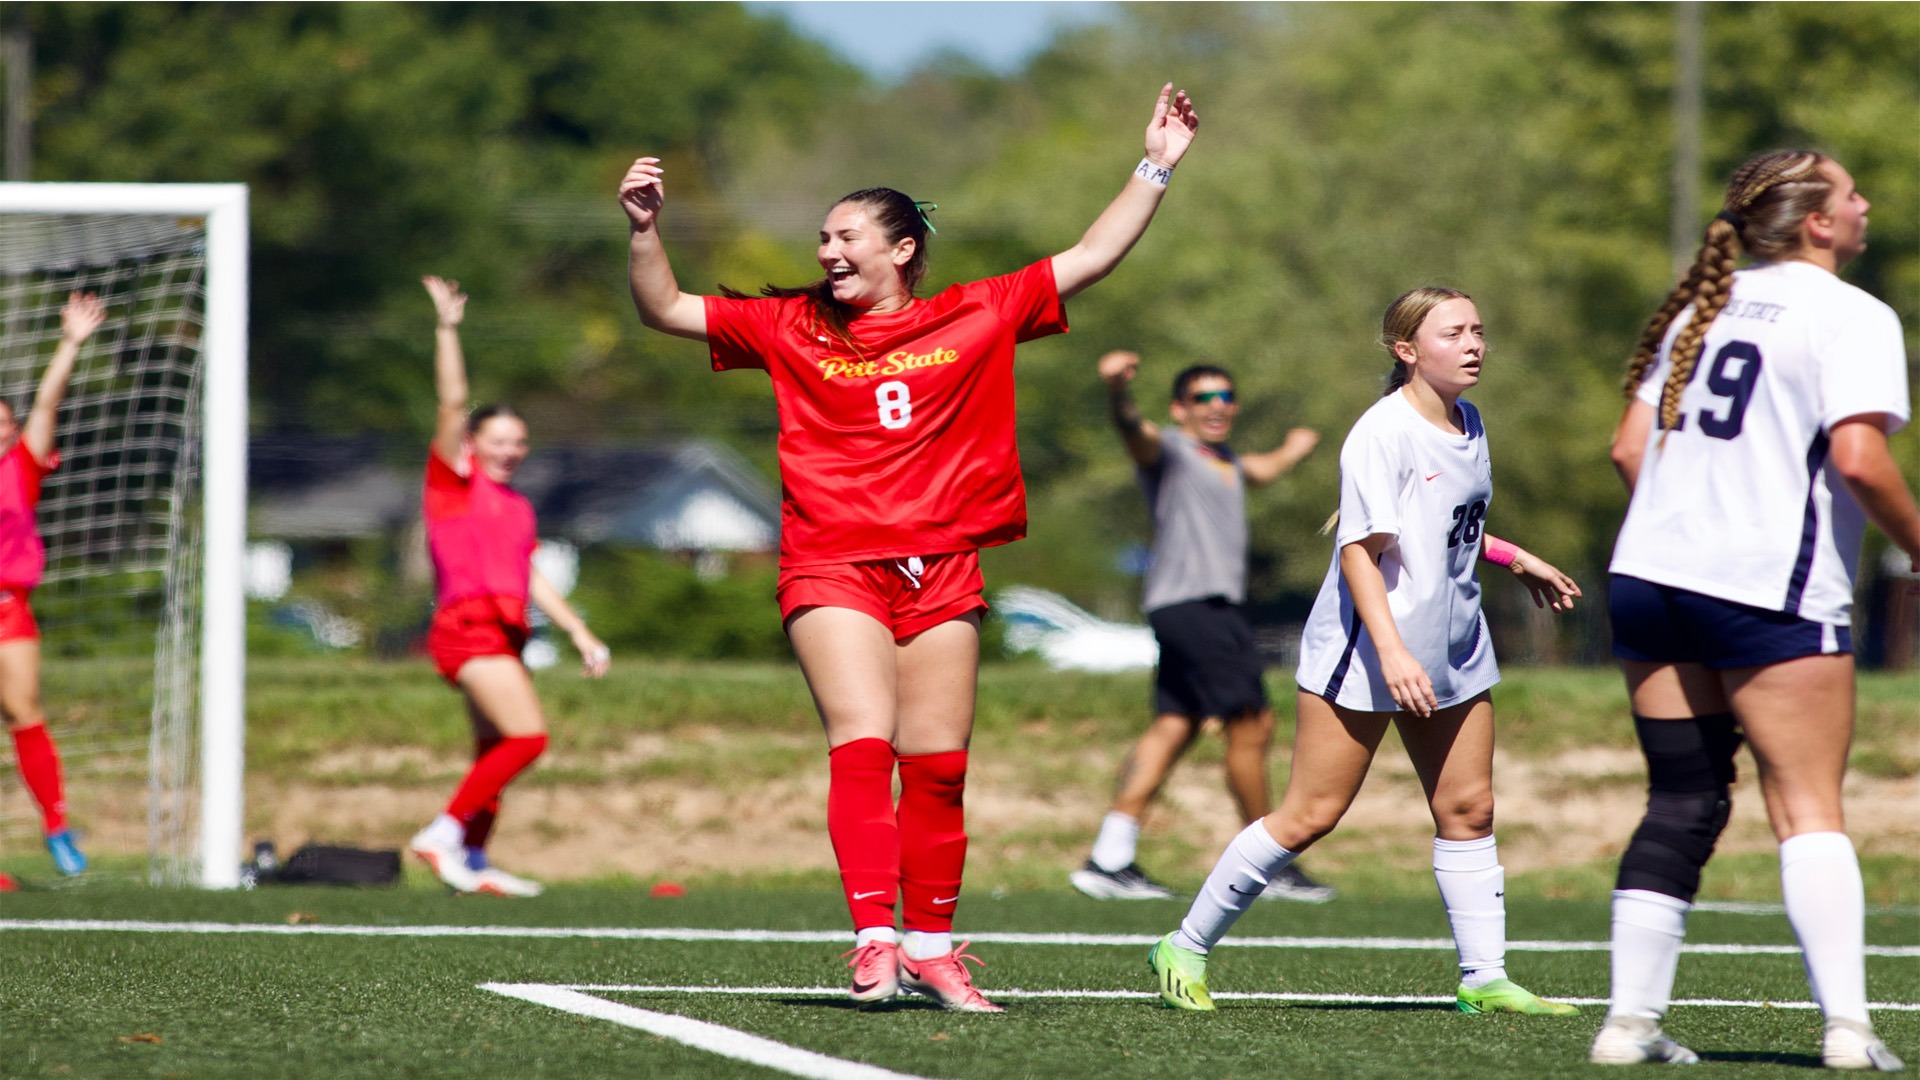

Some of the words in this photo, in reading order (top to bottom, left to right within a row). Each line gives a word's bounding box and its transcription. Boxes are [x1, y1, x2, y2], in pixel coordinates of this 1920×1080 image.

[880, 347, 959, 376] State
[875, 381, 912, 430] 8
[1448, 500, 1486, 549] 28
